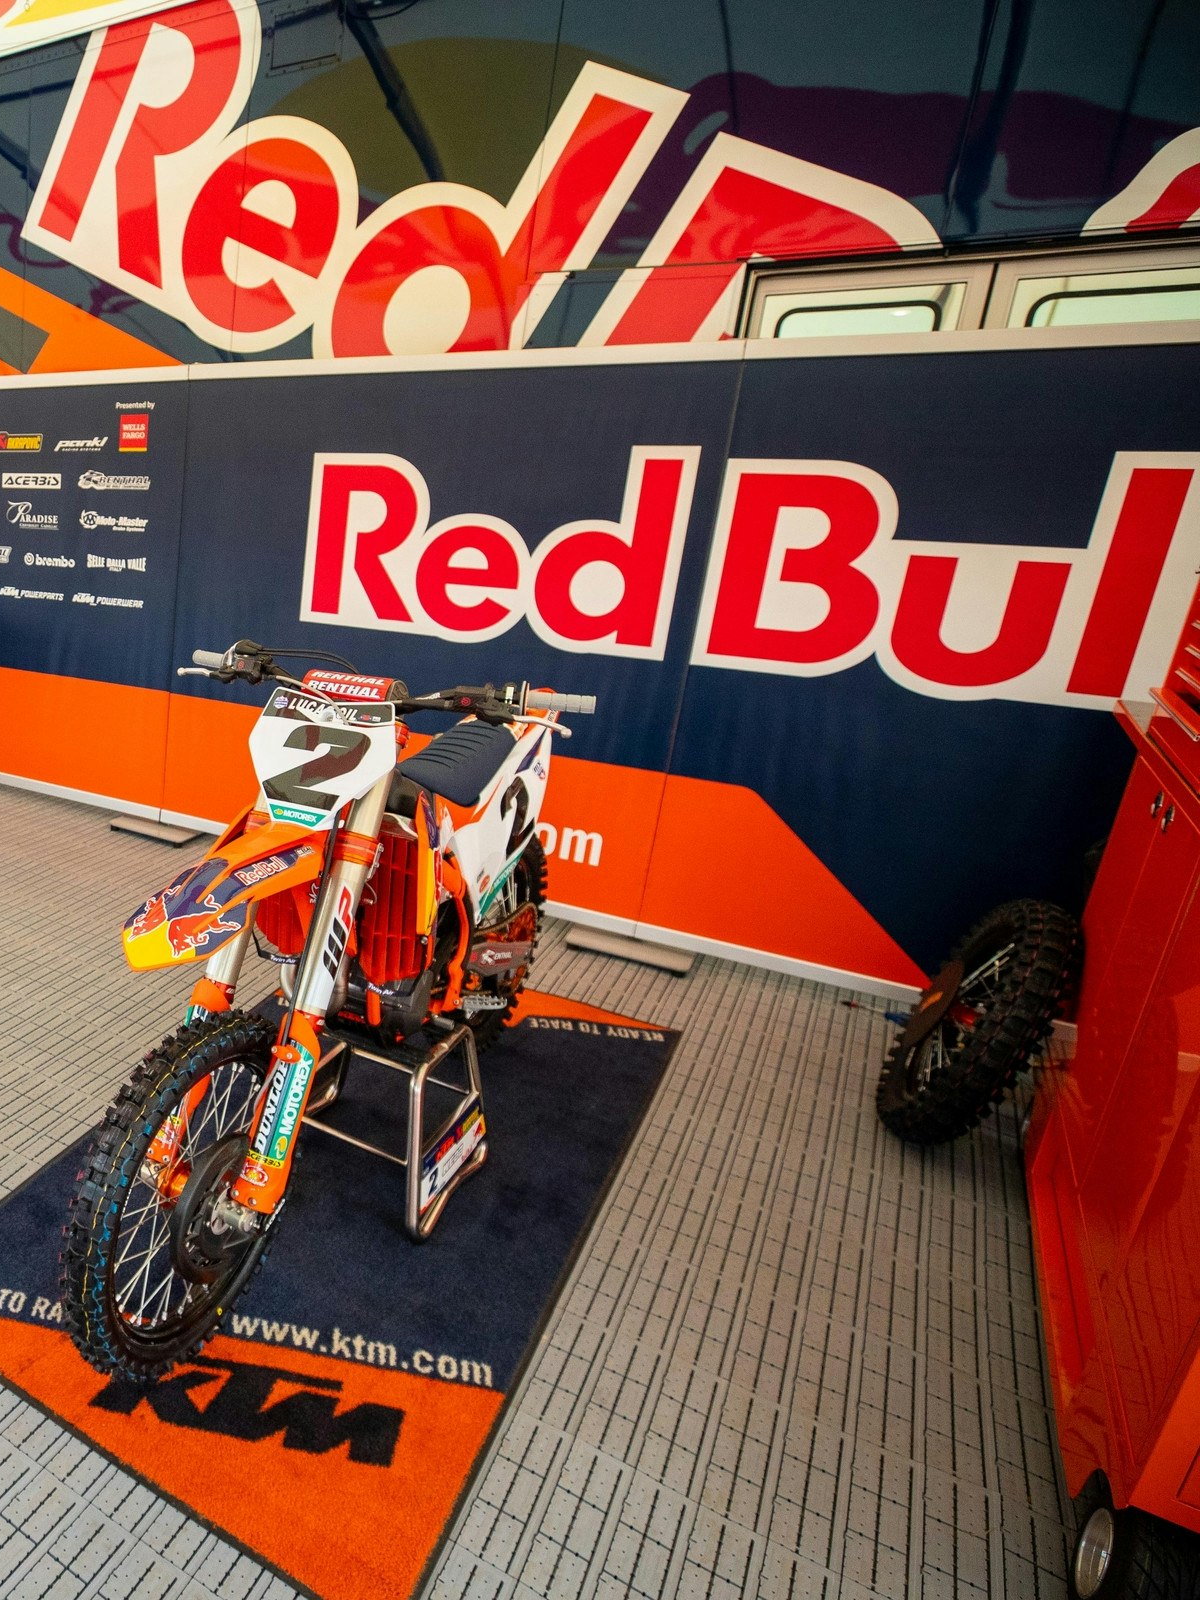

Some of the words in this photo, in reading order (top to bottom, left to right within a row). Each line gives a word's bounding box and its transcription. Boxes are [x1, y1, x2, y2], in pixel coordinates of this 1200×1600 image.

[24, 1, 688, 357] Red
[115, 401, 146, 409] Presented
[147, 401, 155, 409] by
[53, 436, 108, 452] pankl
[5, 475, 60, 486] ACERBIS
[99, 475, 150, 485] RENTHAL
[96, 515, 148, 527] Moto-Master
[35, 554, 76, 568] brembo
[87, 554, 105, 568] SELLE
[106, 558, 126, 569] DALLA
[127, 557, 147, 572] VALLE
[300, 446, 702, 661] Red
[690, 451, 1200, 716] Bul
[311, 671, 386, 686] RENTHAL
[308, 680, 382, 698] RENTHAL
[288, 697, 332, 718] LUCA
[263, 724, 372, 809] 2
[283, 809, 318, 823] MOTOREX
[500, 776, 535, 861] 2
[270, 954, 286, 963] Twin
[368, 982, 382, 994] Twin
[579, 1022, 602, 1036] TO
[279, 1058, 313, 1136] MOTOREX
[428, 1167, 439, 1196] 2
[31, 1299, 64, 1324] RA
[231, 1313, 493, 1388] www.ktm.com
[88, 1355, 407, 1468] KTM
